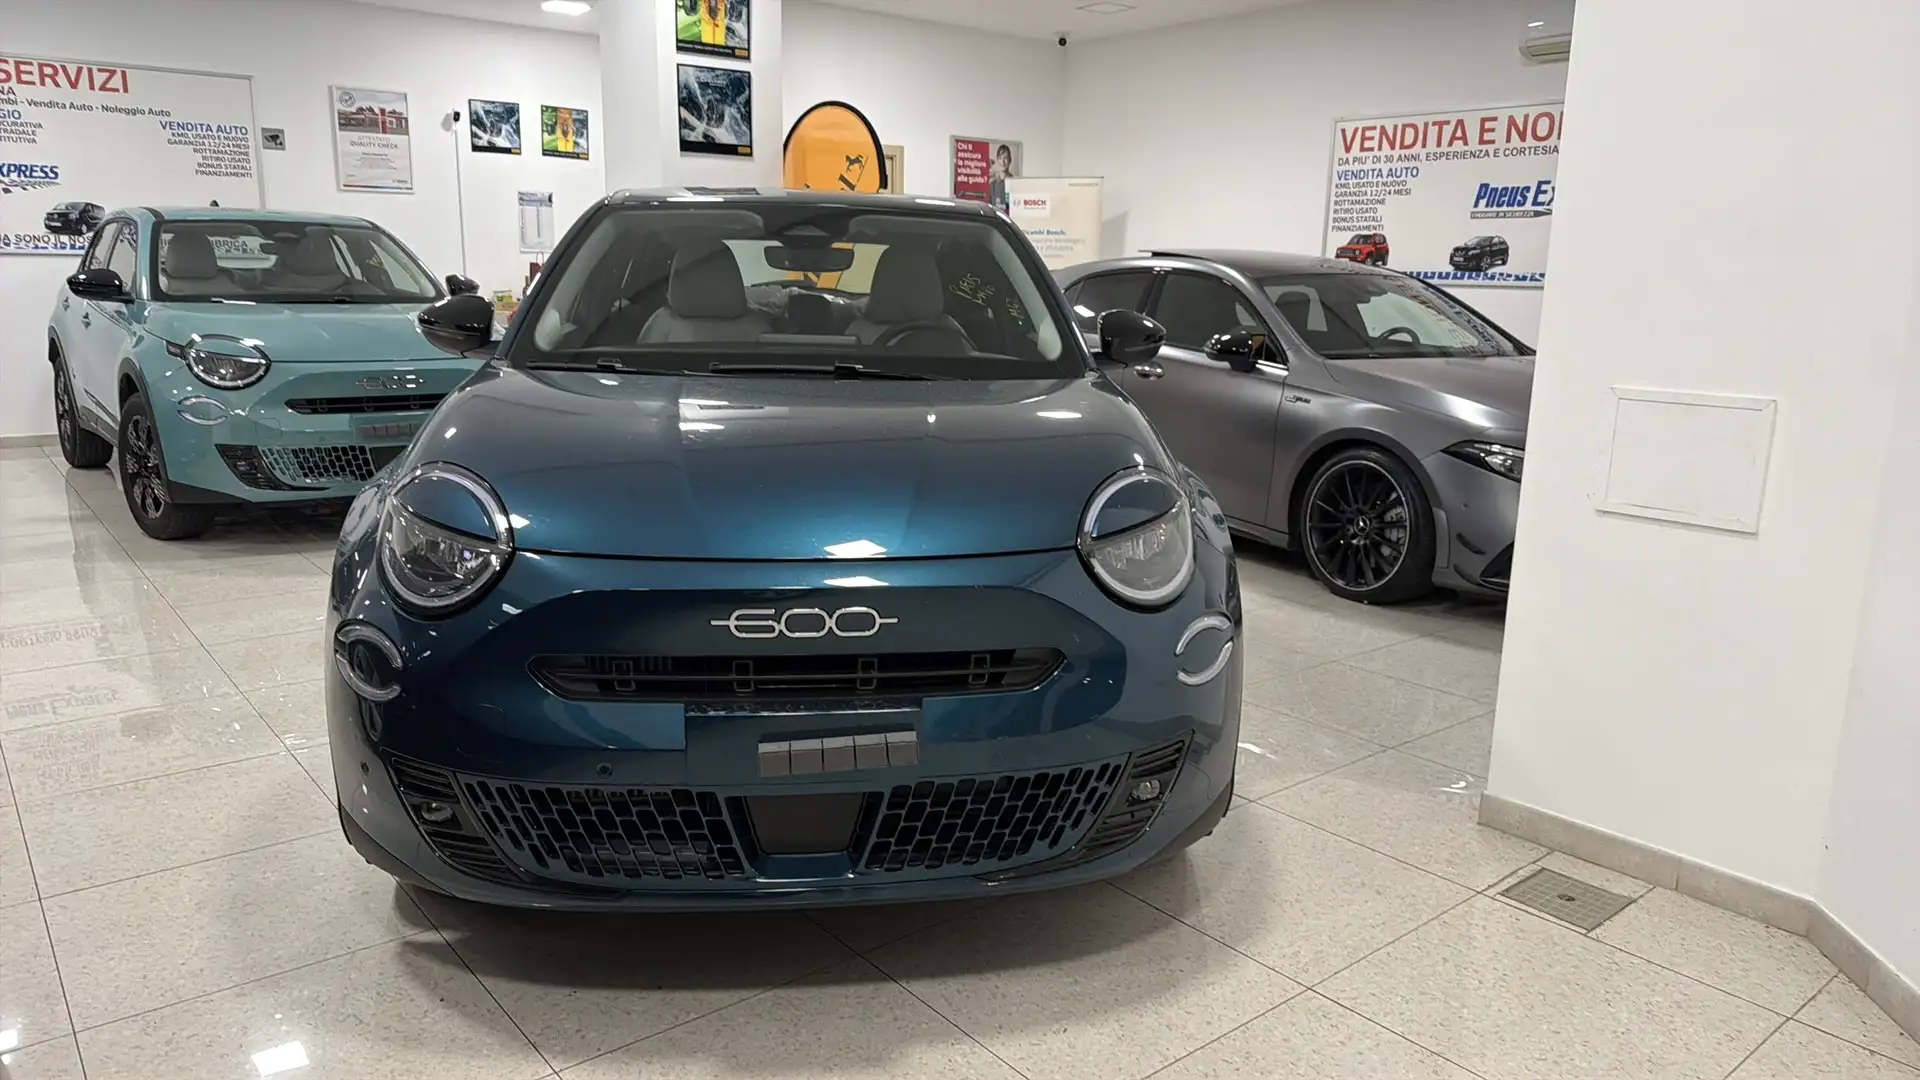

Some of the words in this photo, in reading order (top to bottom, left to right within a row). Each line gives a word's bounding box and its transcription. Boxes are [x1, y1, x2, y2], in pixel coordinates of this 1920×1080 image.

[25, 98, 67, 110] Vendita
[69, 101, 94, 112] Auto
[101, 104, 146, 117] Noleggio
[148, 107, 171, 118] Auto
[159, 120, 213, 134] VENDITA
[216, 124, 249, 136] AUTO
[192, 133, 216, 141] USATO
[223, 135, 249, 143] NUOVO
[1340, 118, 1469, 154] VENDITA
[1478, 115, 1498, 146] E
[167, 138, 206, 148] GARANZIA
[193, 147, 250, 157] ROTTAMAZIONE
[1337, 157, 1350, 167] DA
[1372, 154, 1381, 165] DI
[1383, 154, 1394, 164] 30
[1396, 152, 1422, 163] ANNI,
[1425, 148, 1490, 162] ESPERIENZA
[1493, 148, 1500, 158] E
[1503, 144, 1560, 157] CORTESIA
[1336, 168, 1384, 181] VENDITA
[1386, 166, 1419, 179] AUTO
[1352, 181, 1374, 189] USATO
[1381, 180, 1407, 188] NUOVO
[1334, 190, 1368, 199] GARANZIA
[1369, 189, 1392, 198] 12/24
[1393, 188, 1412, 196] MESI
[1473, 183, 1531, 208] Pneus
[1333, 198, 1386, 207] ROTTAMAZIONE
[1333, 207, 1354, 216] RITIRO
[1355, 207, 1378, 215] USATO
[1356, 215, 1382, 224] STATALI
[1331, 224, 1384, 233] FINANZIAMENTI
[14, 233, 51, 244] SONO
[724, 606, 886, 638] 600
